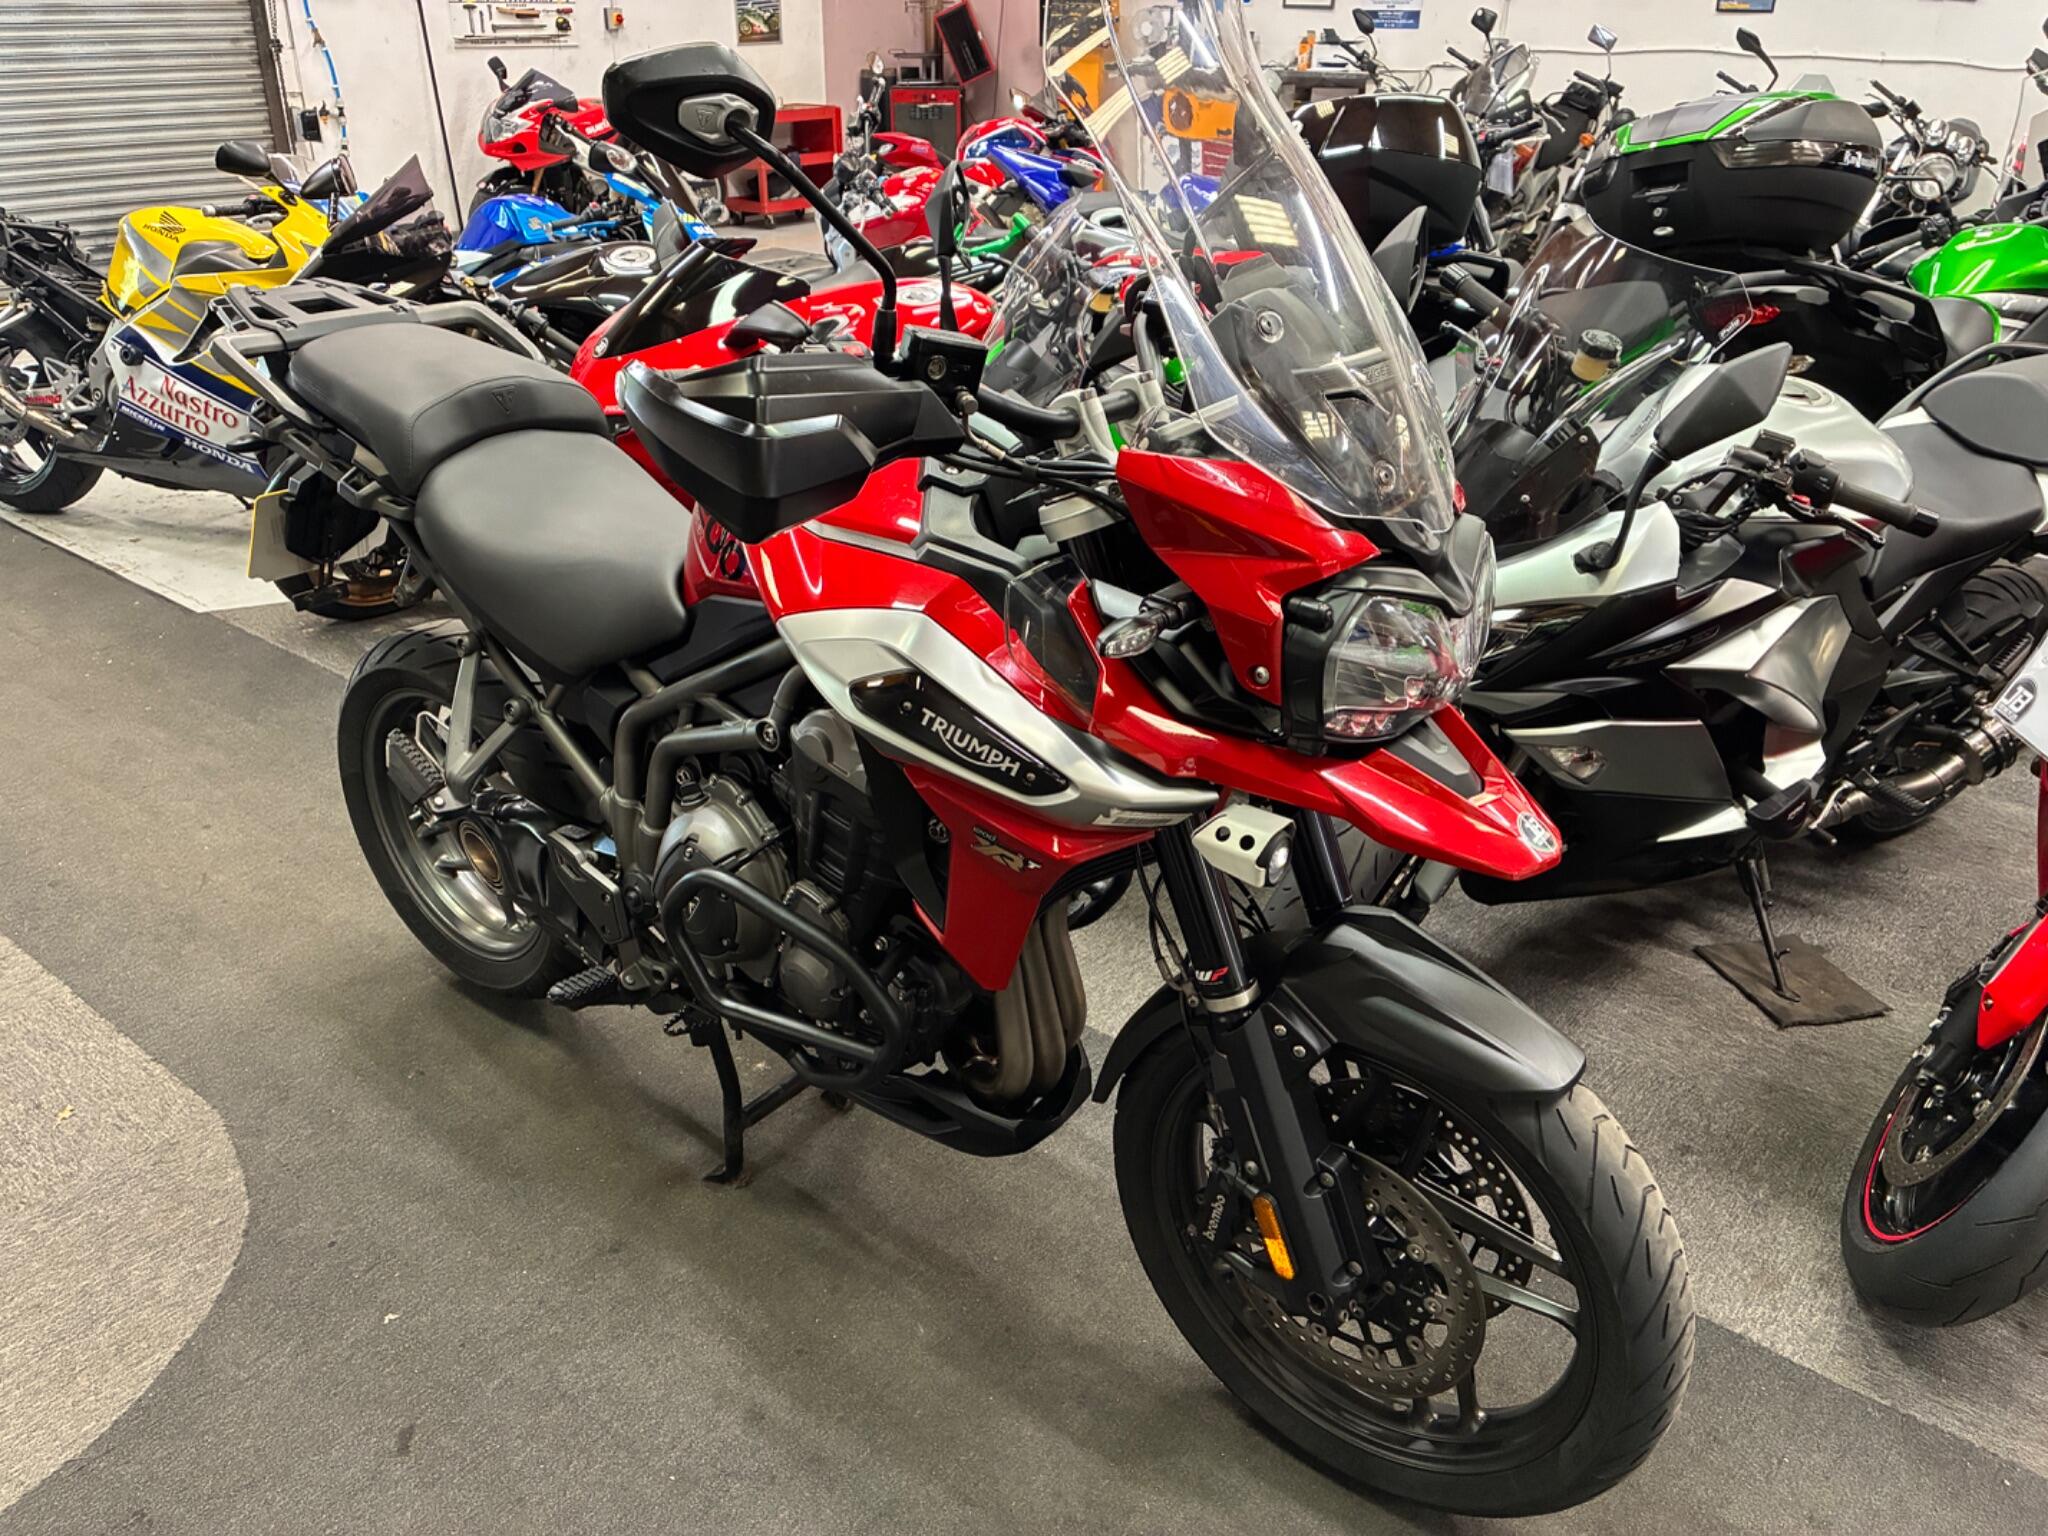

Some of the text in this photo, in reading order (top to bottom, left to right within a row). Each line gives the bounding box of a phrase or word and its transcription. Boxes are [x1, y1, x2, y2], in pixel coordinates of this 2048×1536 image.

[120, 405, 166, 432] MICHELIN
[121, 375, 210, 437] Azzurro
[160, 374, 240, 429] Nastro
[184, 436, 255, 474] HONDA
[920, 706, 1021, 777] TRIUMPH
[1195, 965, 1229, 982] WP
[1202, 1194, 1226, 1241] brembo
